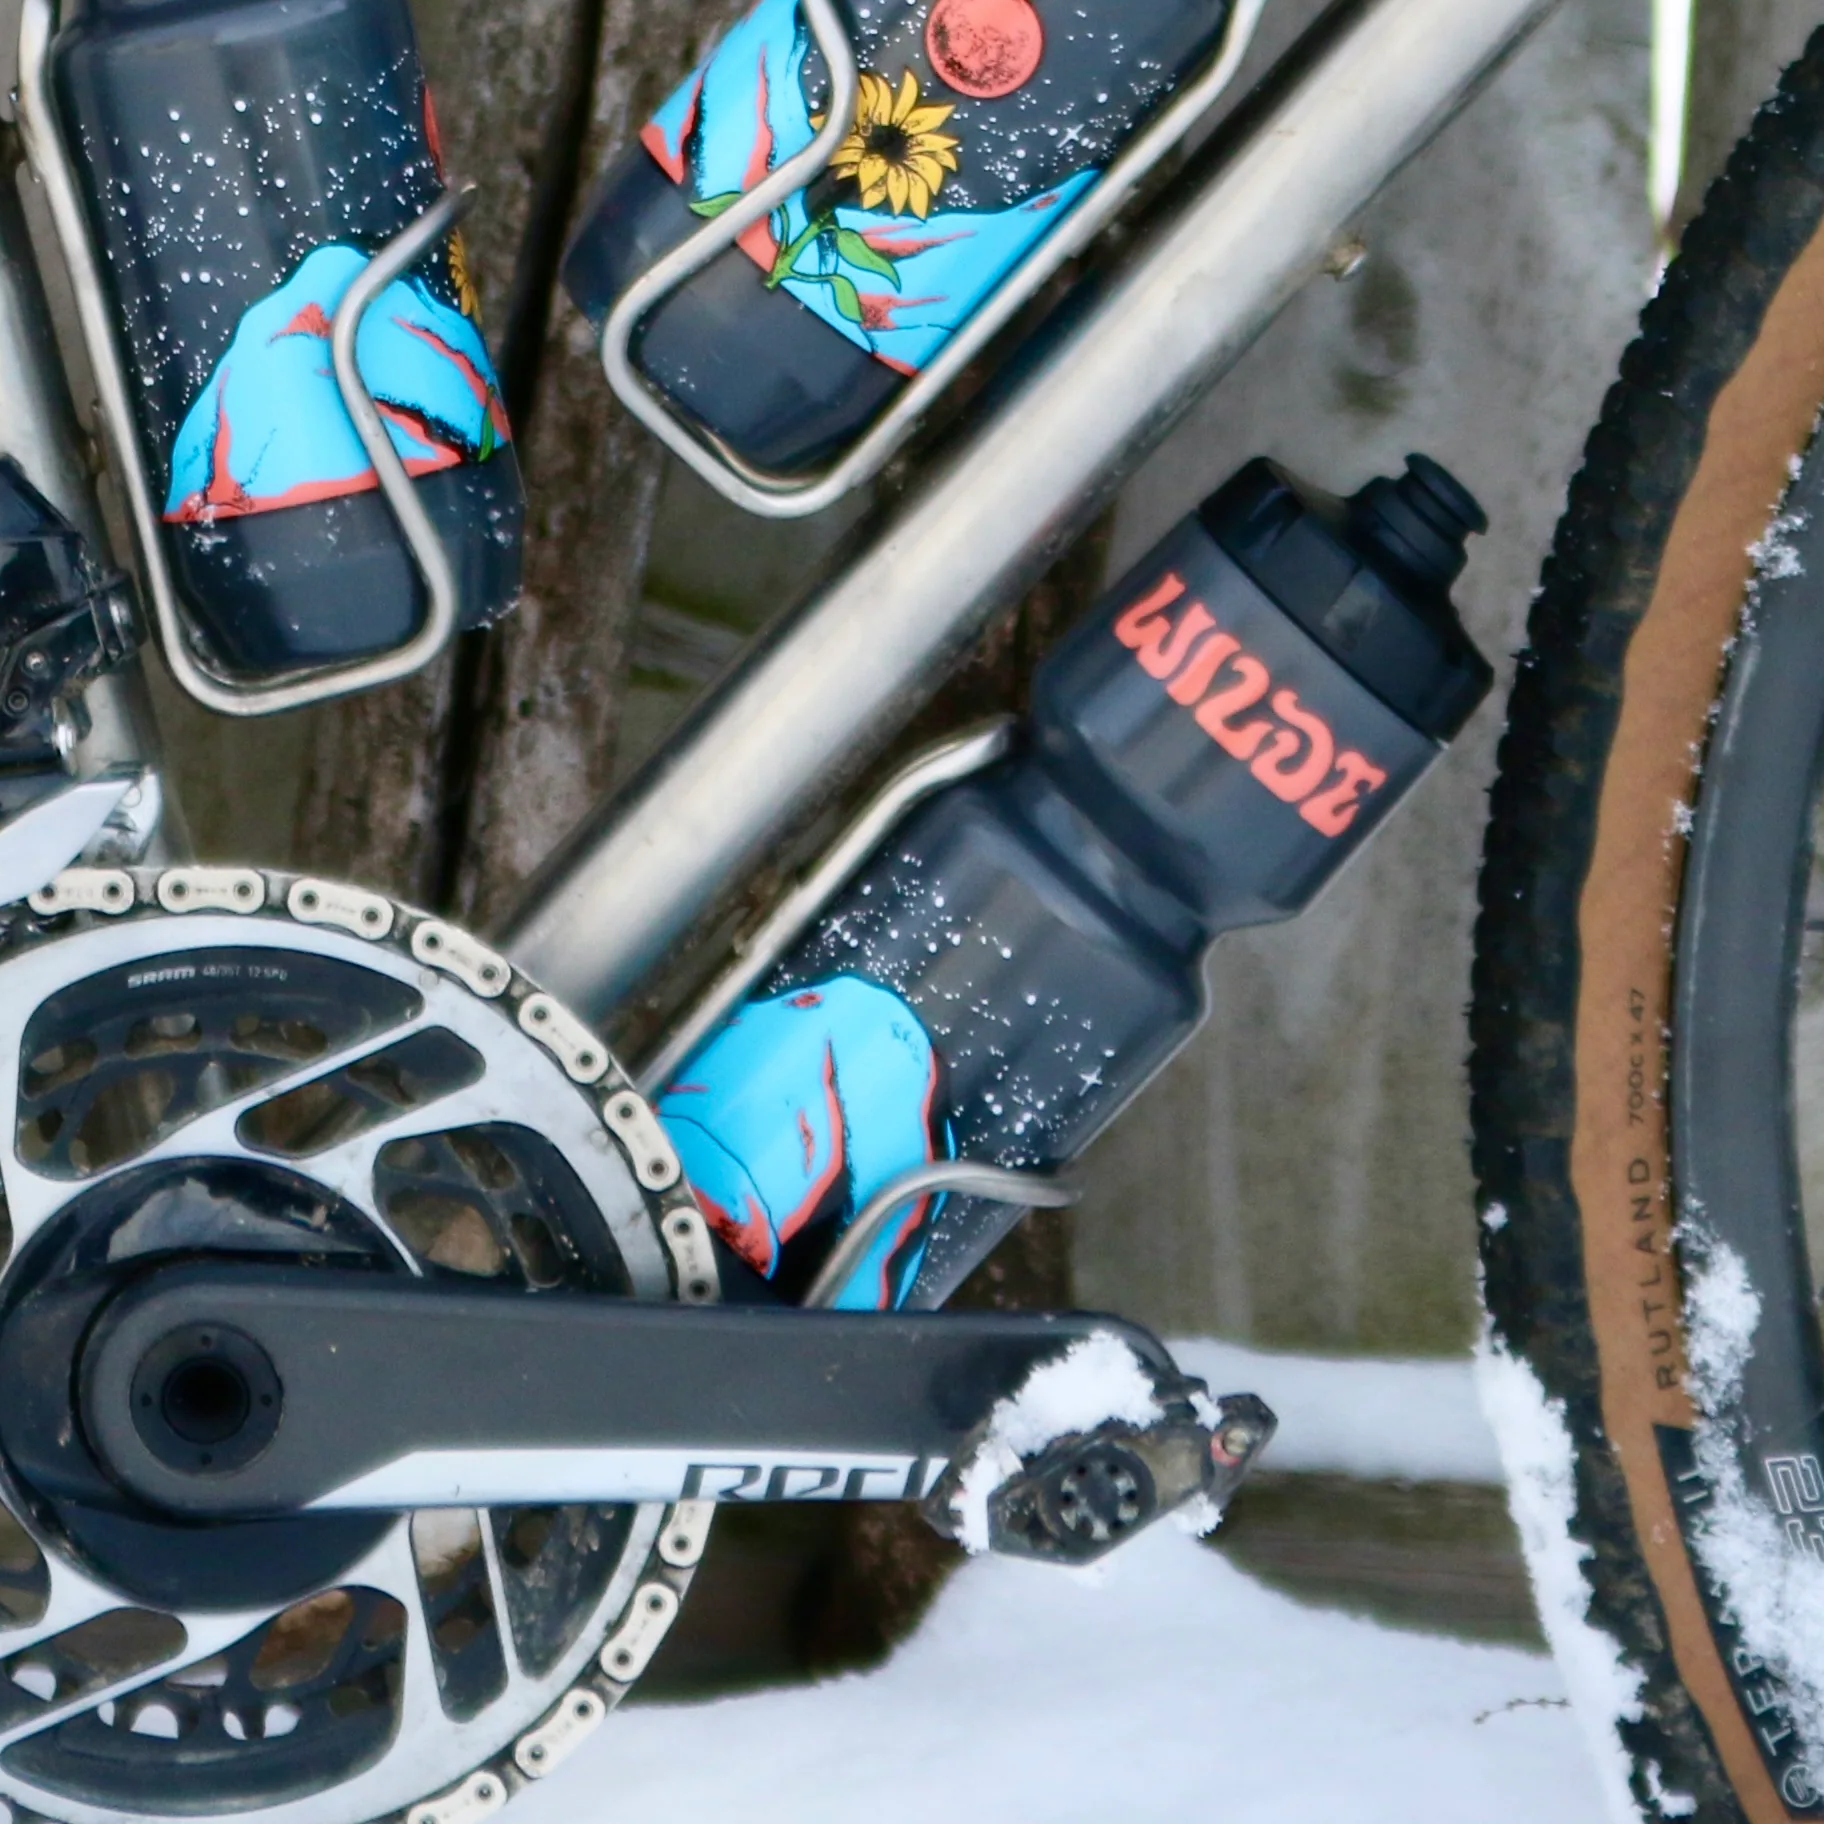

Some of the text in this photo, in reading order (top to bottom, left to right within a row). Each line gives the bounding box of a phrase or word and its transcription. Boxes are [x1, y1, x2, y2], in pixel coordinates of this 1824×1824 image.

[1112, 572, 1388, 838] WILDE
[1629, 987, 1646, 1024] 47
[1628, 1157, 1679, 1392] RUTLAND
